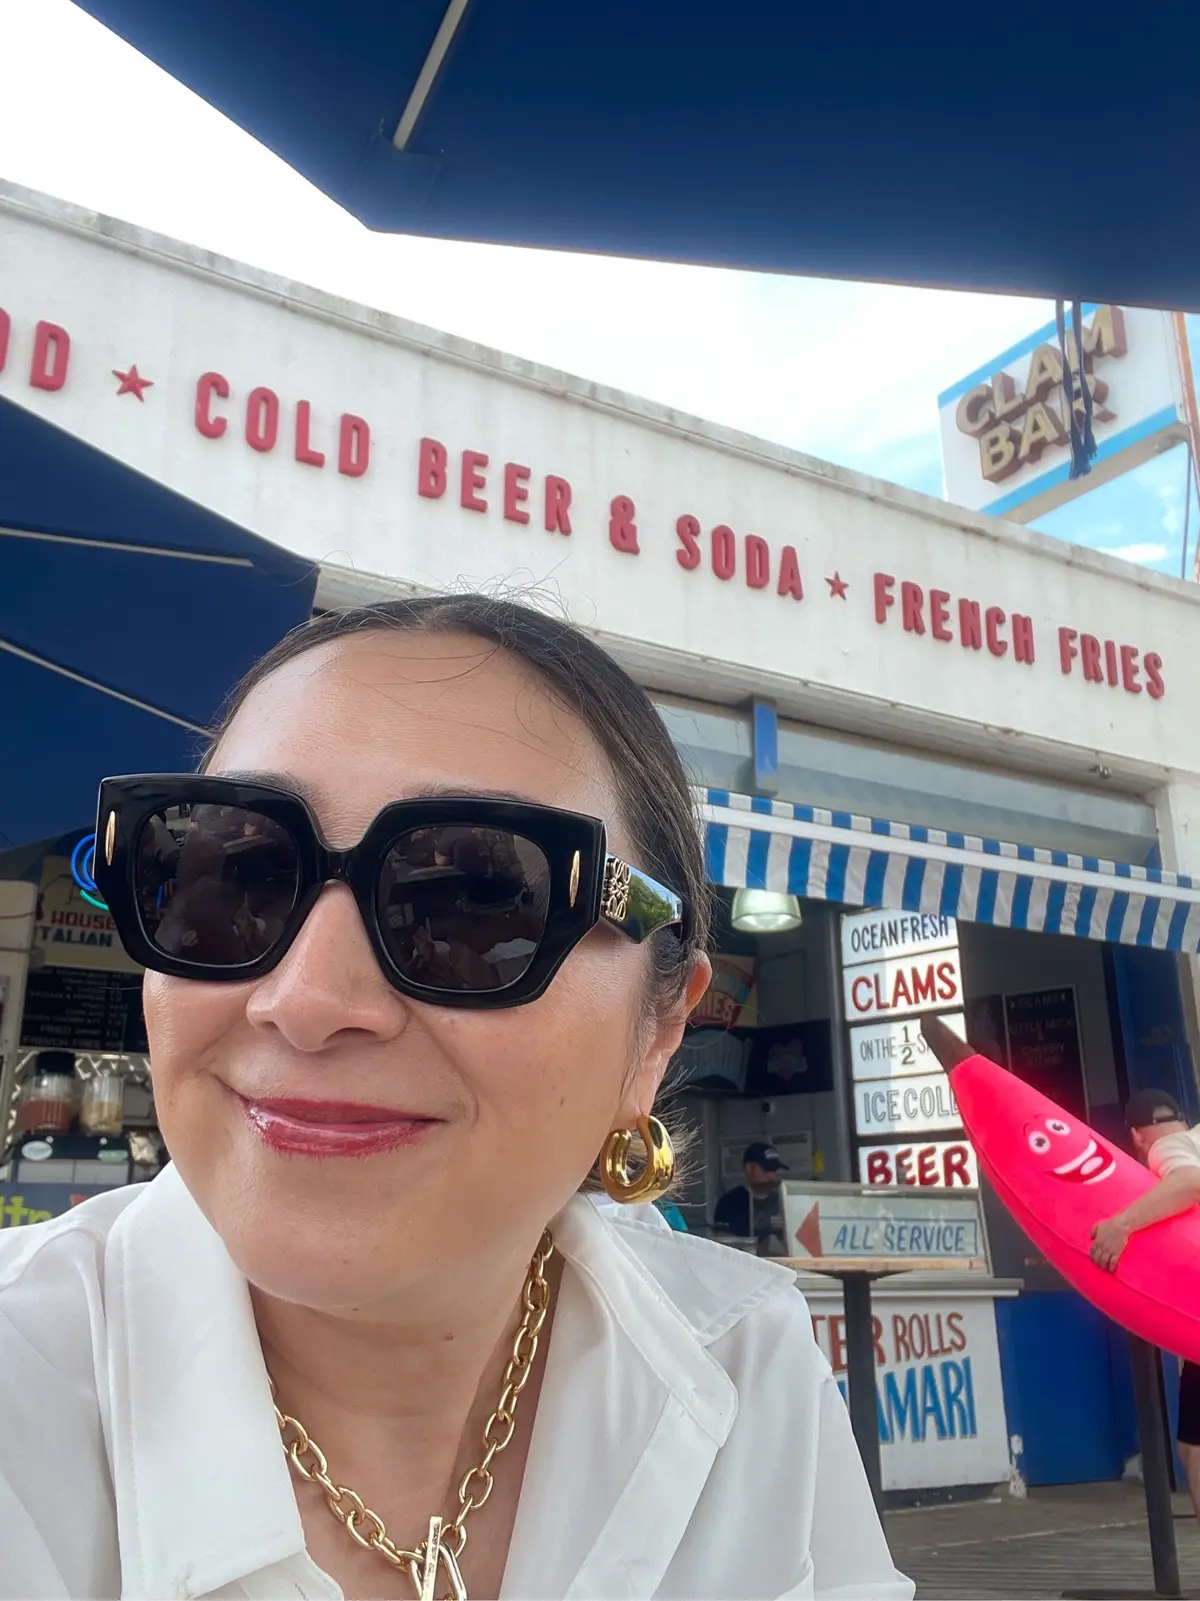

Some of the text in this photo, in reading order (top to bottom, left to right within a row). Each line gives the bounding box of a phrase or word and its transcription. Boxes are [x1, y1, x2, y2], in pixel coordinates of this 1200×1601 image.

[956, 304, 1128, 437] CLAM
[194, 372, 371, 478] COLD
[417, 438, 572, 536] BEER
[609, 495, 640, 555] &
[675, 514, 803, 600] SODA
[873, 573, 1035, 665] FRENCH
[1058, 627, 1165, 699] FRIES
[850, 919, 899, 952] OCEAN
[852, 961, 957, 1012] CLAMS
[859, 1039, 874, 1062] ON
[874, 1036, 897, 1059] THE
[916, 1032, 930, 1054] S
[863, 1089, 901, 1124] ICE
[867, 1145, 971, 1187] BEER
[833, 1223, 966, 1254] ALL SERVICE
[892, 1311, 967, 1364] ROLLS
